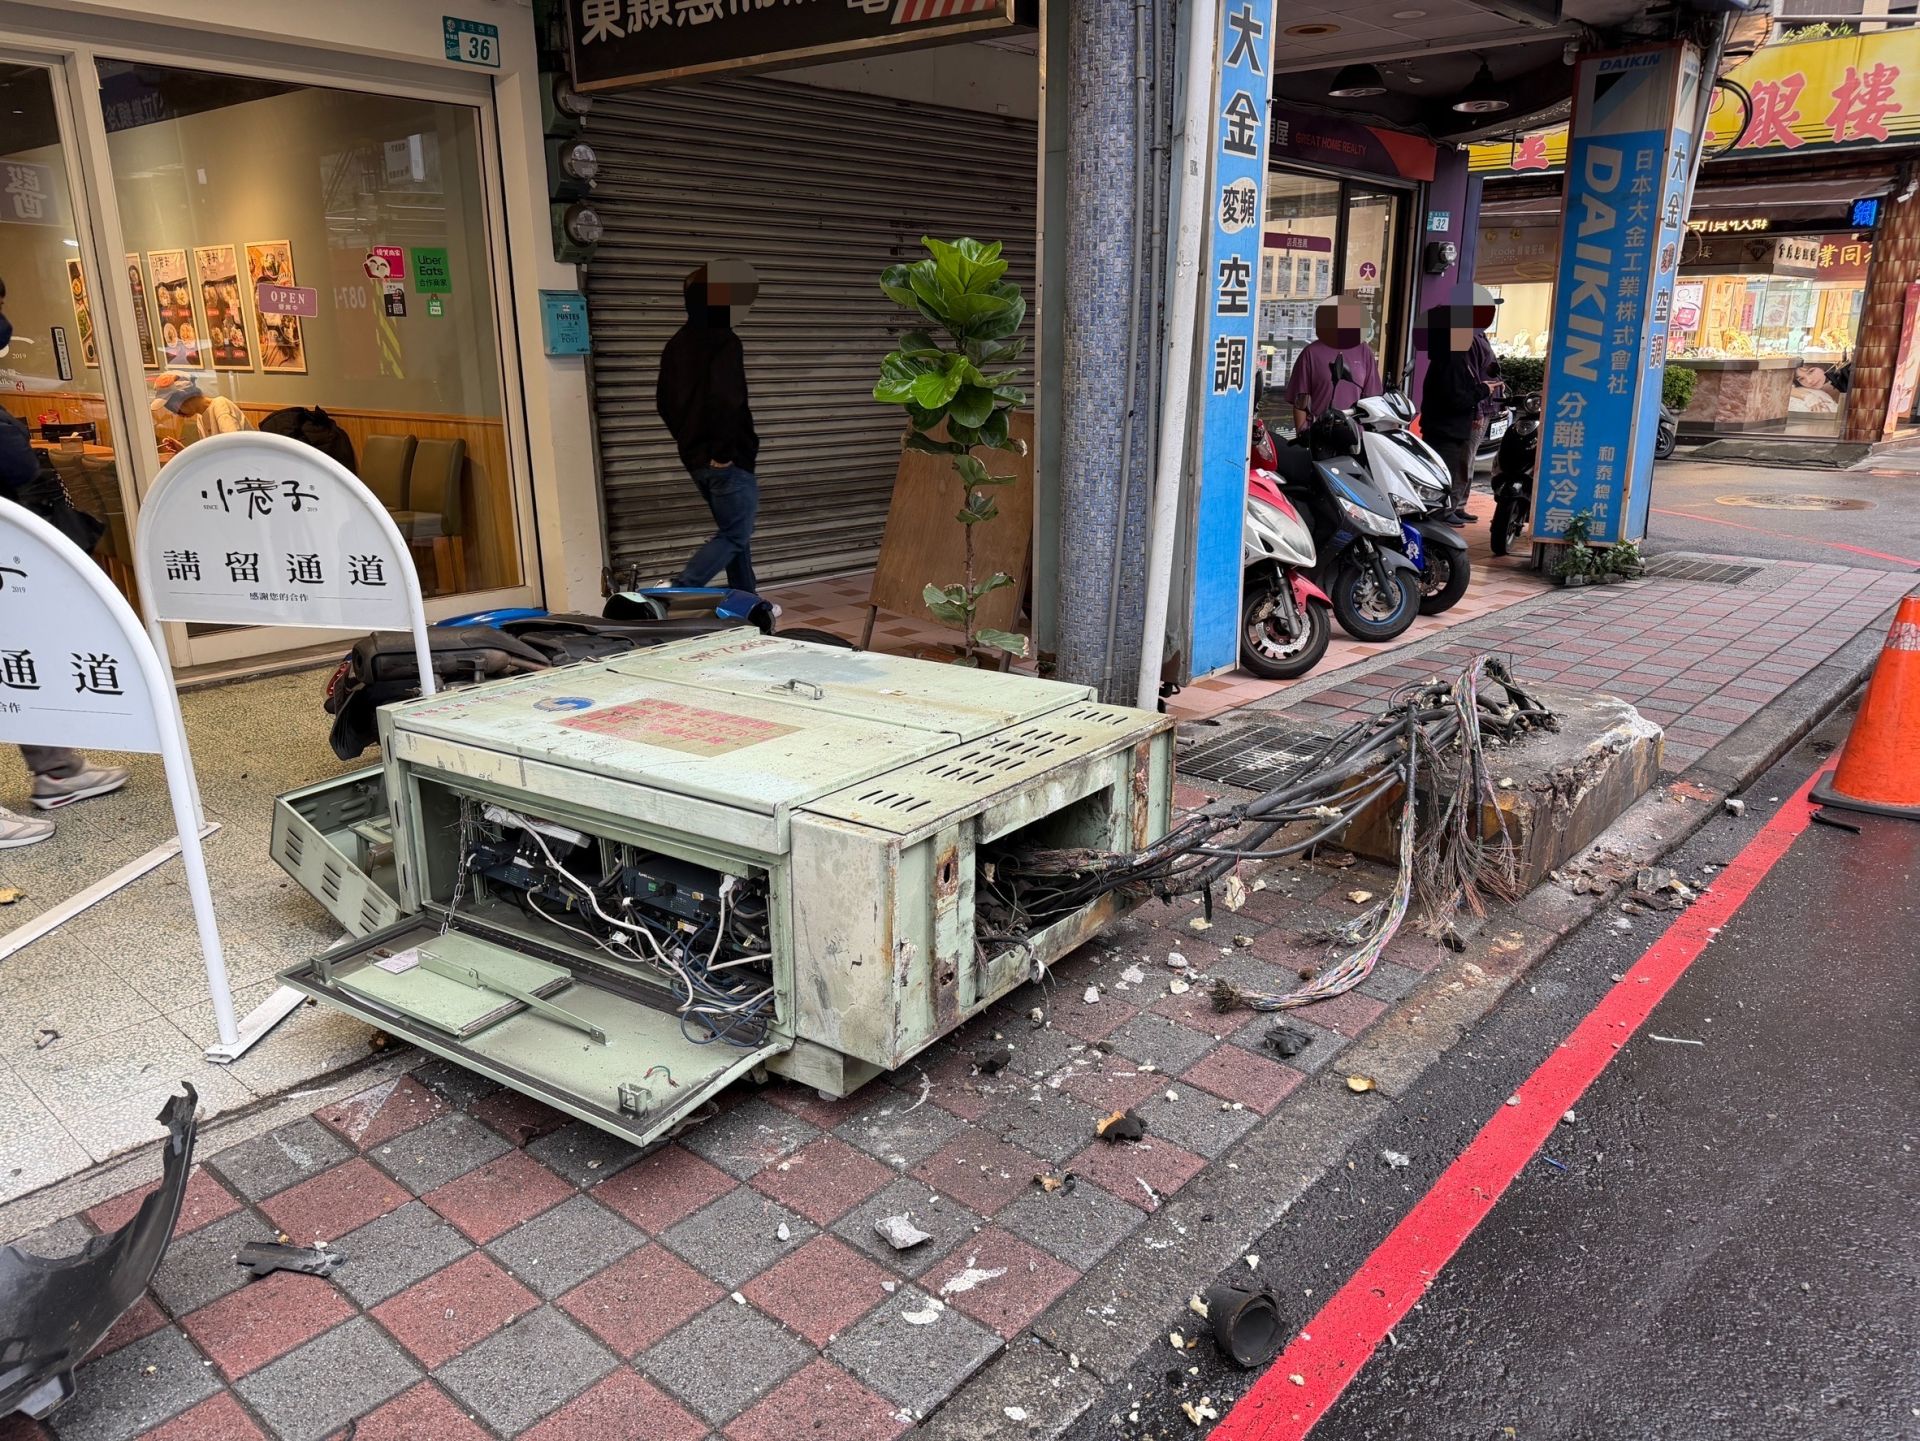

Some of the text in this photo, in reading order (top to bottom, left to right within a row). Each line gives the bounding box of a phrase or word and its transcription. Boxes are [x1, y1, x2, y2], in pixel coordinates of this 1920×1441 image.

[469, 36, 491, 60] 36
[1599, 53, 1663, 71] DAIKIN
[1295, 132, 1367, 155] GREAT HOME REALTY
[1435, 218, 1446, 229] 32
[418, 256, 442, 265] Uber
[1562, 145, 1624, 382] DAIKIN
[420, 266, 444, 276] Eats
[1607, 149, 1654, 395] 日本大金工業株式會社
[420, 279, 447, 287] 合作商家
[270, 291, 305, 304] OPEN
[201, 477, 320, 520] 小巷子
[12, 586, 26, 594] 2019
[249, 592, 309, 602] 感謝您的合作
